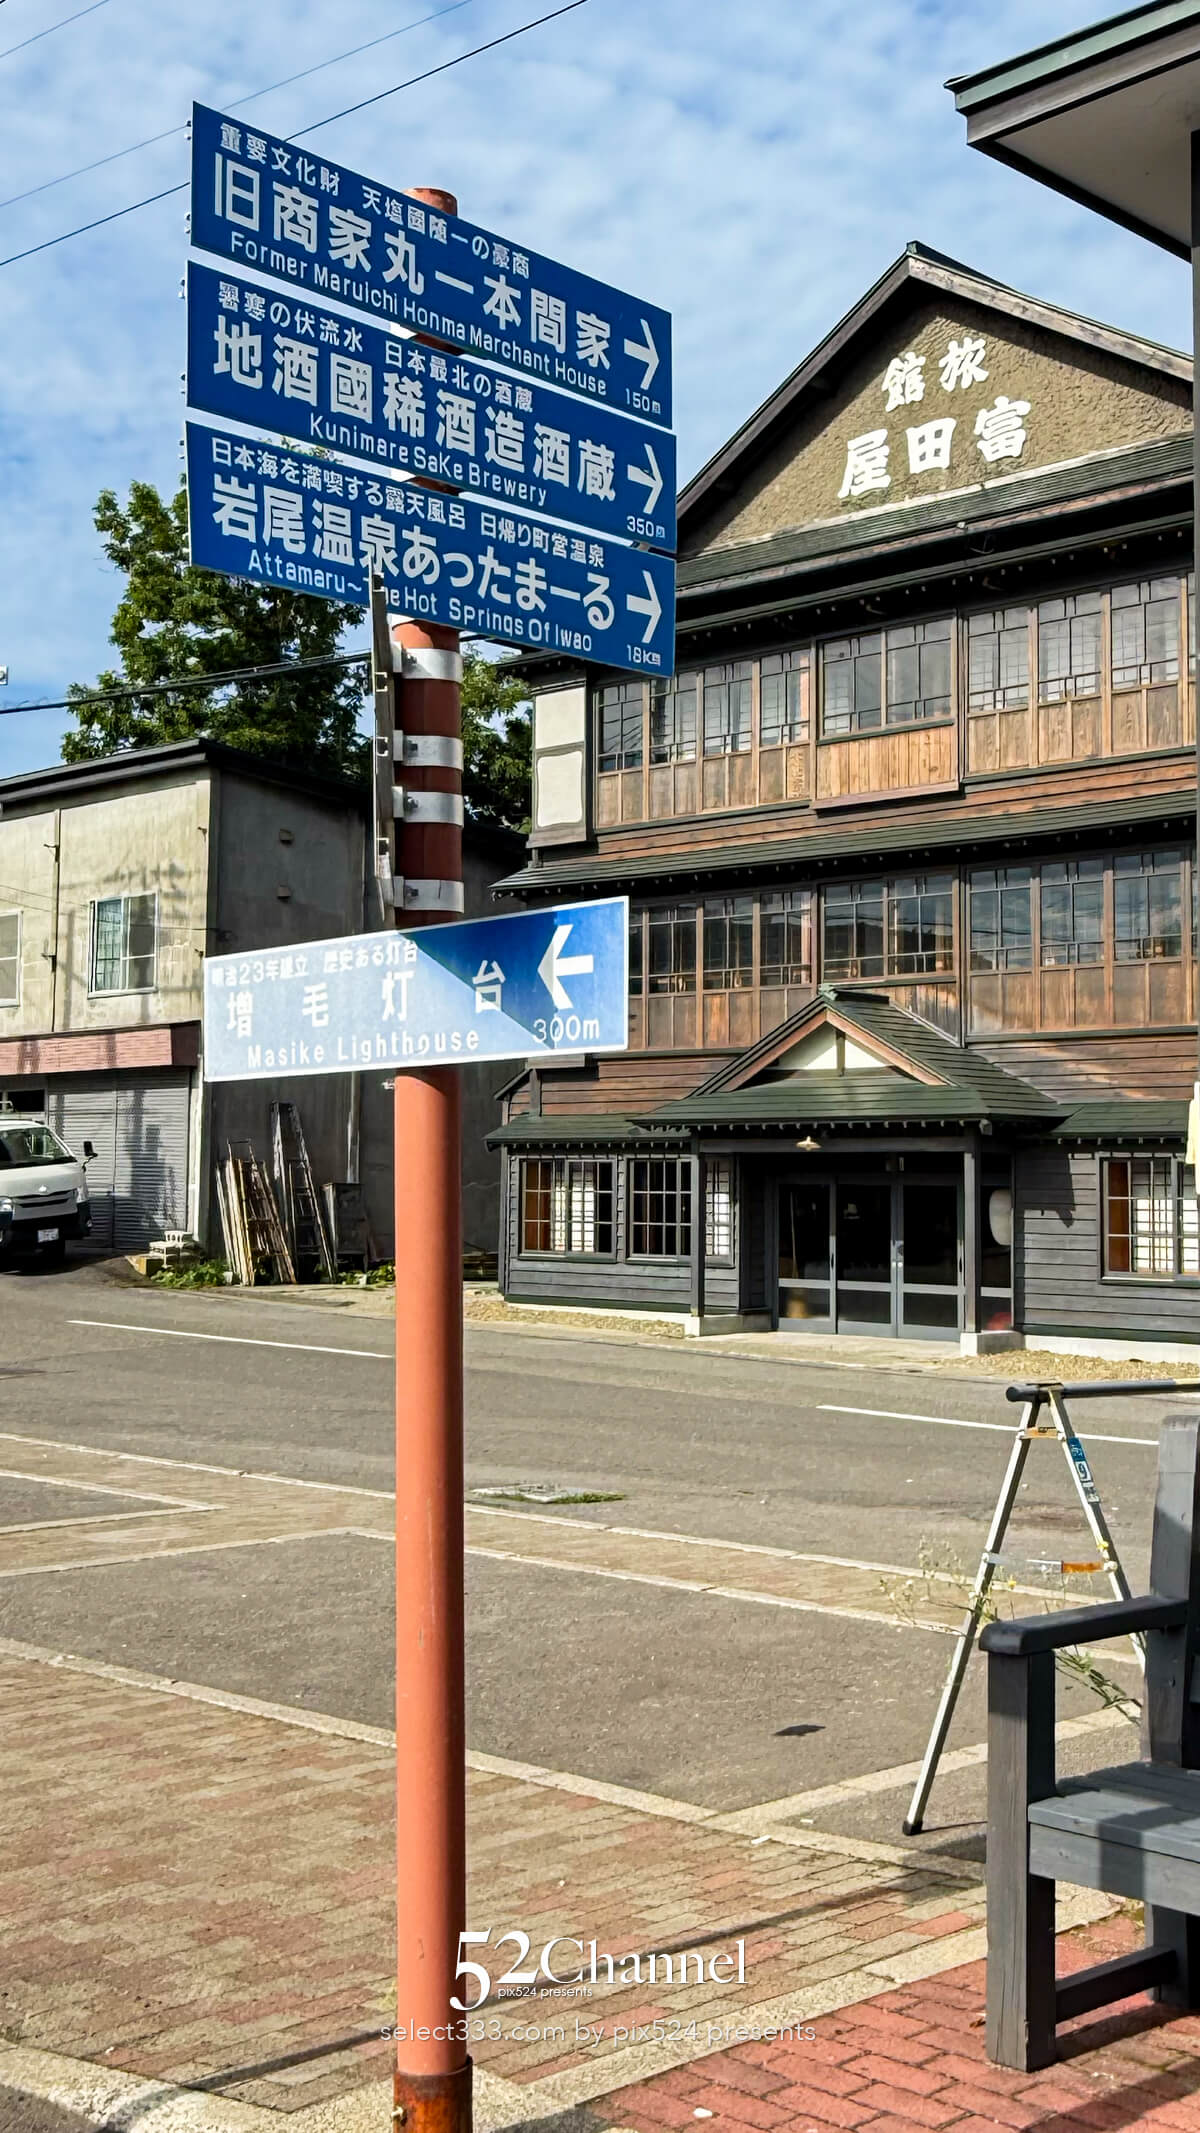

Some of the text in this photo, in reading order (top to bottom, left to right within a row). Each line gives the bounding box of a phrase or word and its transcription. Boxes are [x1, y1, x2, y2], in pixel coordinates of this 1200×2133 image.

[220, 122, 340, 197] 重要文化財
[214, 152, 612, 371] 旧商家丸一本間家
[231, 232, 607, 396] Former Maruichi Honma Marchant House
[213, 314, 616, 502] 地酒國稀酒造酒蔵
[385, 340, 533, 412] 日本最北の酒蔵
[310, 412, 409, 464] Kunimare
[468, 462, 547, 507] Brewery
[211, 437, 605, 569] 日本海を満喫する露天風呂 日帰り町営温泉
[212, 473, 615, 631] 岩尾温泉あったまーる
[404, 586, 438, 616] Hot
[449, 597, 524, 638] Springs
[528, 617, 550, 643] Of
[555, 623, 592, 652] Iwao
[323, 940, 418, 974] 歴史ある灯台
[226, 959, 507, 1039] 増毛灯台
[533, 1013, 600, 1043] 300m
[247, 1029, 479, 1069] Masike Lighthouse
